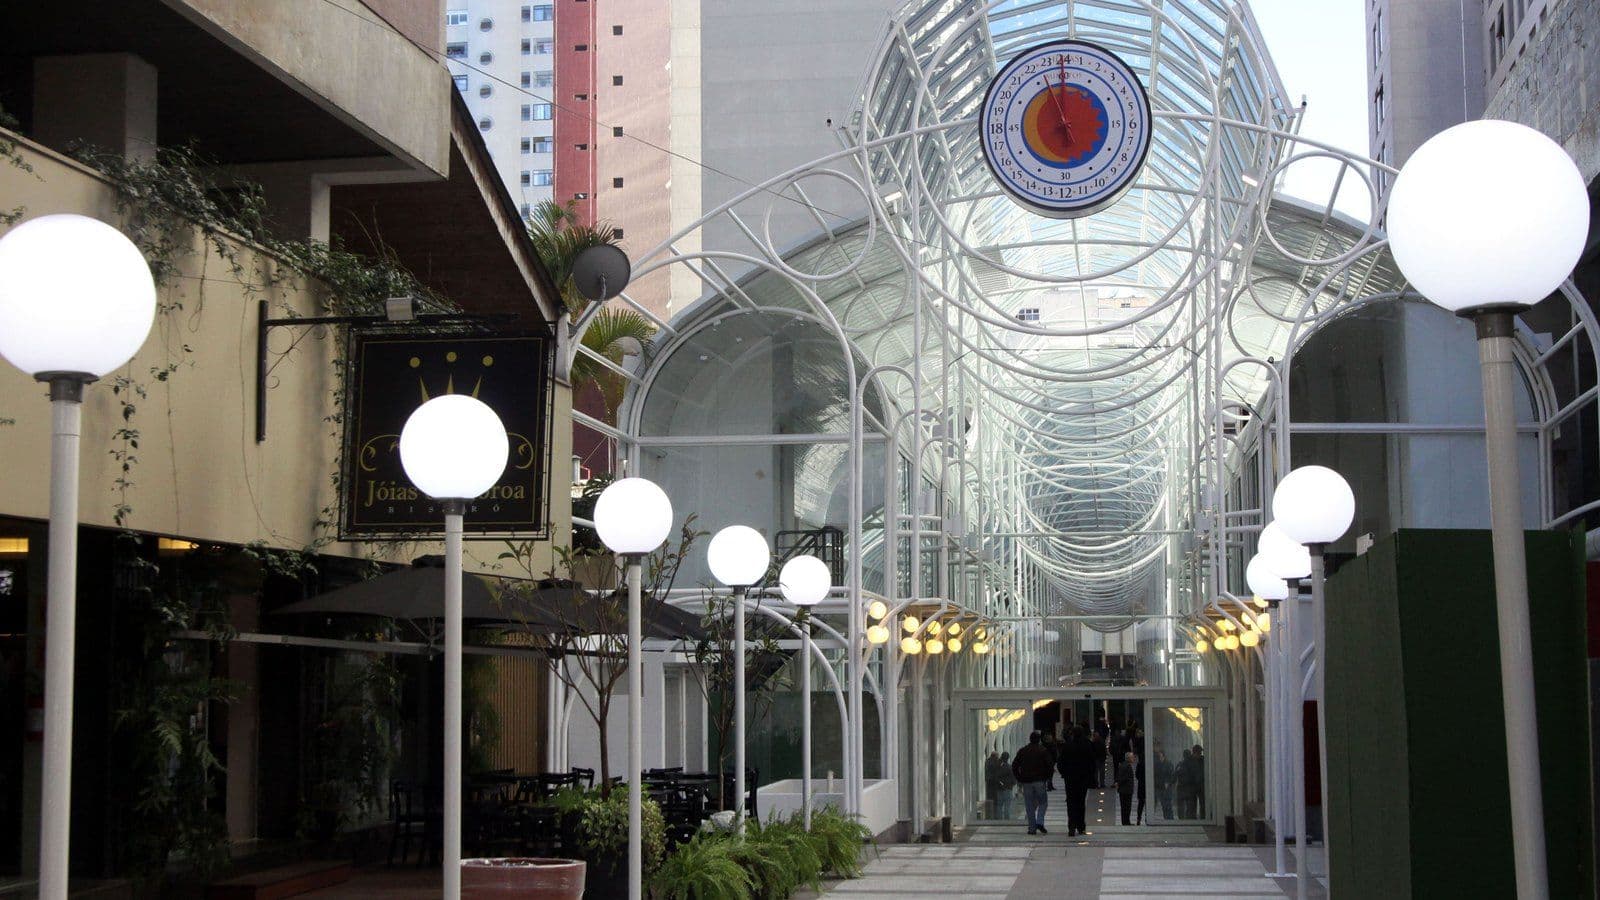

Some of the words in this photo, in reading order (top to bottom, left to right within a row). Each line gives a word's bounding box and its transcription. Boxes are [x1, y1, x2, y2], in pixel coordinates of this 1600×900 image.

[1041, 57, 1052, 66] 23
[1056, 54, 1071, 65] 24
[1025, 65, 1036, 73] 22
[1011, 76, 1021, 85] 21
[1000, 90, 1011, 99] 20
[994, 107, 1004, 116] 19
[1129, 119, 1136, 128] 6
[991, 124, 1003, 134] 18
[994, 142, 1004, 150] 17
[1001, 158, 1011, 166] 16
[1026, 181, 1037, 190] 14
[1094, 179, 1105, 187] 10
[1043, 186, 1053, 195] 13
[1059, 188, 1072, 198] 12
[364, 480, 418, 507] Jóias
[388, 504, 500, 513] BISRÓ
